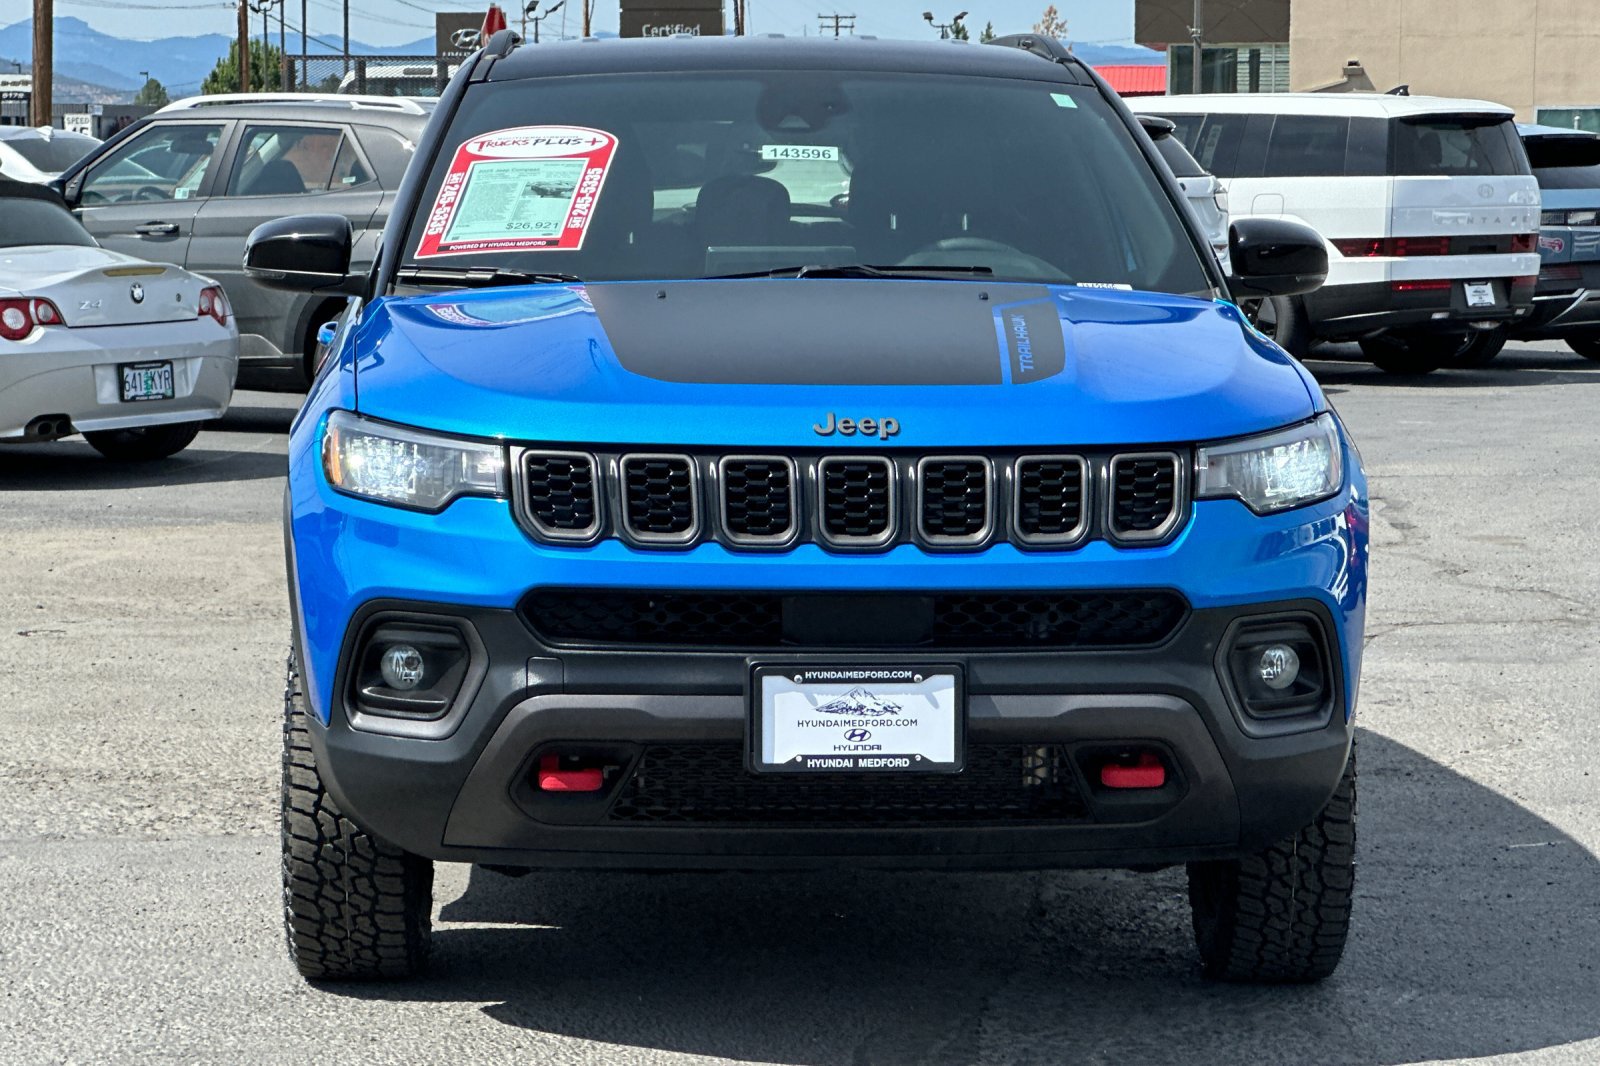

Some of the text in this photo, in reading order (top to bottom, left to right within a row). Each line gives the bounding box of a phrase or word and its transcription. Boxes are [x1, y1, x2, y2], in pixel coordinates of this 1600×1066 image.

[473, 138, 584, 152] TRUCKS PLUS
[769, 148, 832, 160] 143596
[571, 167, 603, 216] 245-5335
[427, 184, 461, 235] 245-5335
[505, 221, 560, 230] $26,921
[449, 243, 479, 251] POWERED
[79, 300, 102, 310] Z4
[1011, 314, 1034, 372] TRAILHAWK
[124, 369, 171, 392] 641 KYR
[813, 412, 900, 440] Jeep
[804, 671, 912, 679] HYUNDAIMEDFORD.COM
[797, 719, 918, 728] HYUNDAIMEDFORD.COM
[833, 744, 882, 752] HYUNDAI
[807, 758, 910, 768] HYUNDAI MEDFORD
